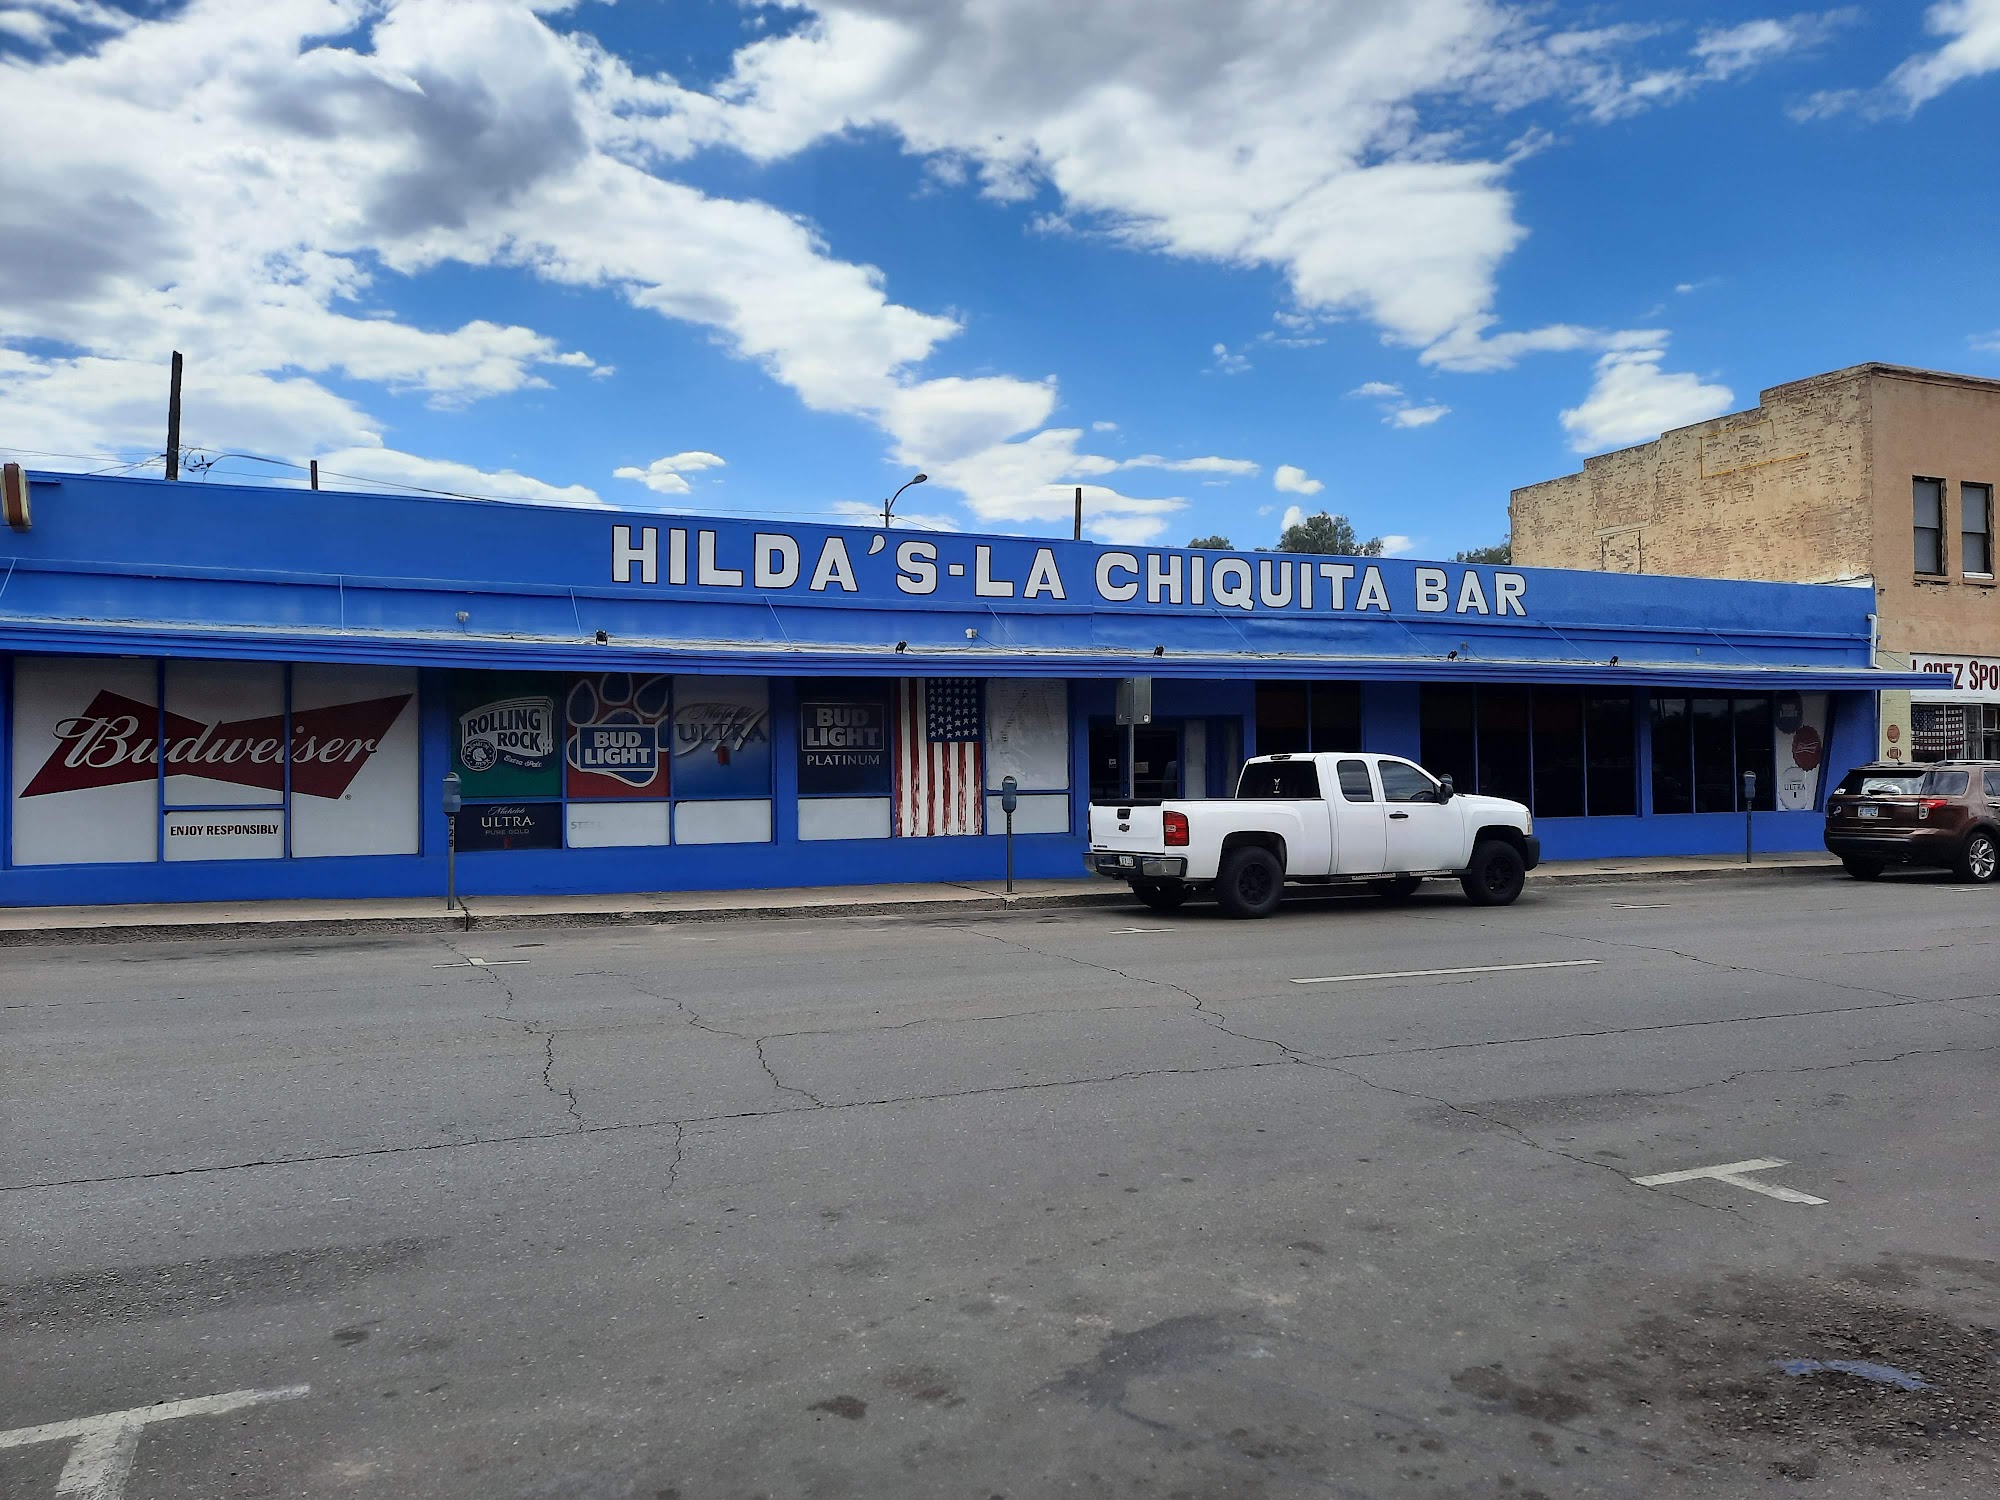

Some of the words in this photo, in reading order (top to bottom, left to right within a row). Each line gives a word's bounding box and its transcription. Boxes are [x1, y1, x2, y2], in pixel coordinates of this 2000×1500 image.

[1095, 551, 1391, 611] CHIQUITA
[1415, 567, 1527, 616] BAR
[1969, 660, 2000, 690] SPO
[467, 708, 541, 737] ROLLING
[817, 708, 869, 726] BUD
[52, 715, 379, 768] Budweiser
[497, 731, 541, 752] ROCK
[593, 731, 643, 748] BUD
[676, 723, 767, 742] ULTRA
[806, 727, 880, 746] LIGHT
[584, 748, 651, 765] LIGHT
[806, 755, 880, 765] PLATINUM
[170, 825, 203, 836] ENJOY
[206, 823, 279, 836] RESPONSIBLY
[481, 816, 533, 827] ULTRA
